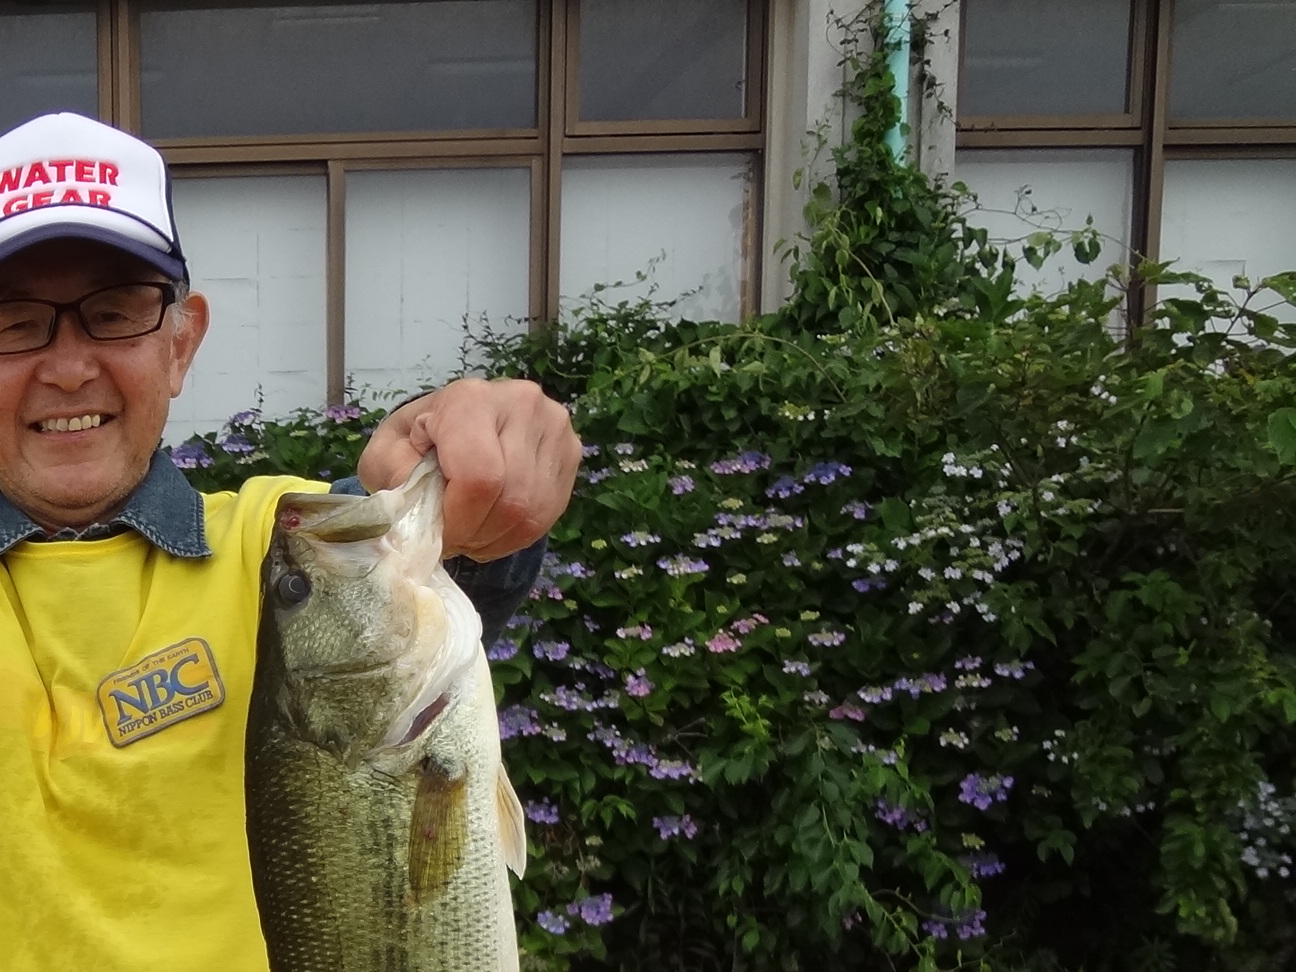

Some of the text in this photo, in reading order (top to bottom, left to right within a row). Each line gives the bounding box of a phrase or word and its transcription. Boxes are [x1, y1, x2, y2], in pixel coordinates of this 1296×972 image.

[3, 189, 111, 215] GEAR
[109, 653, 209, 725] NBC
[119, 690, 213, 736] NIPPON BASS CLUB
